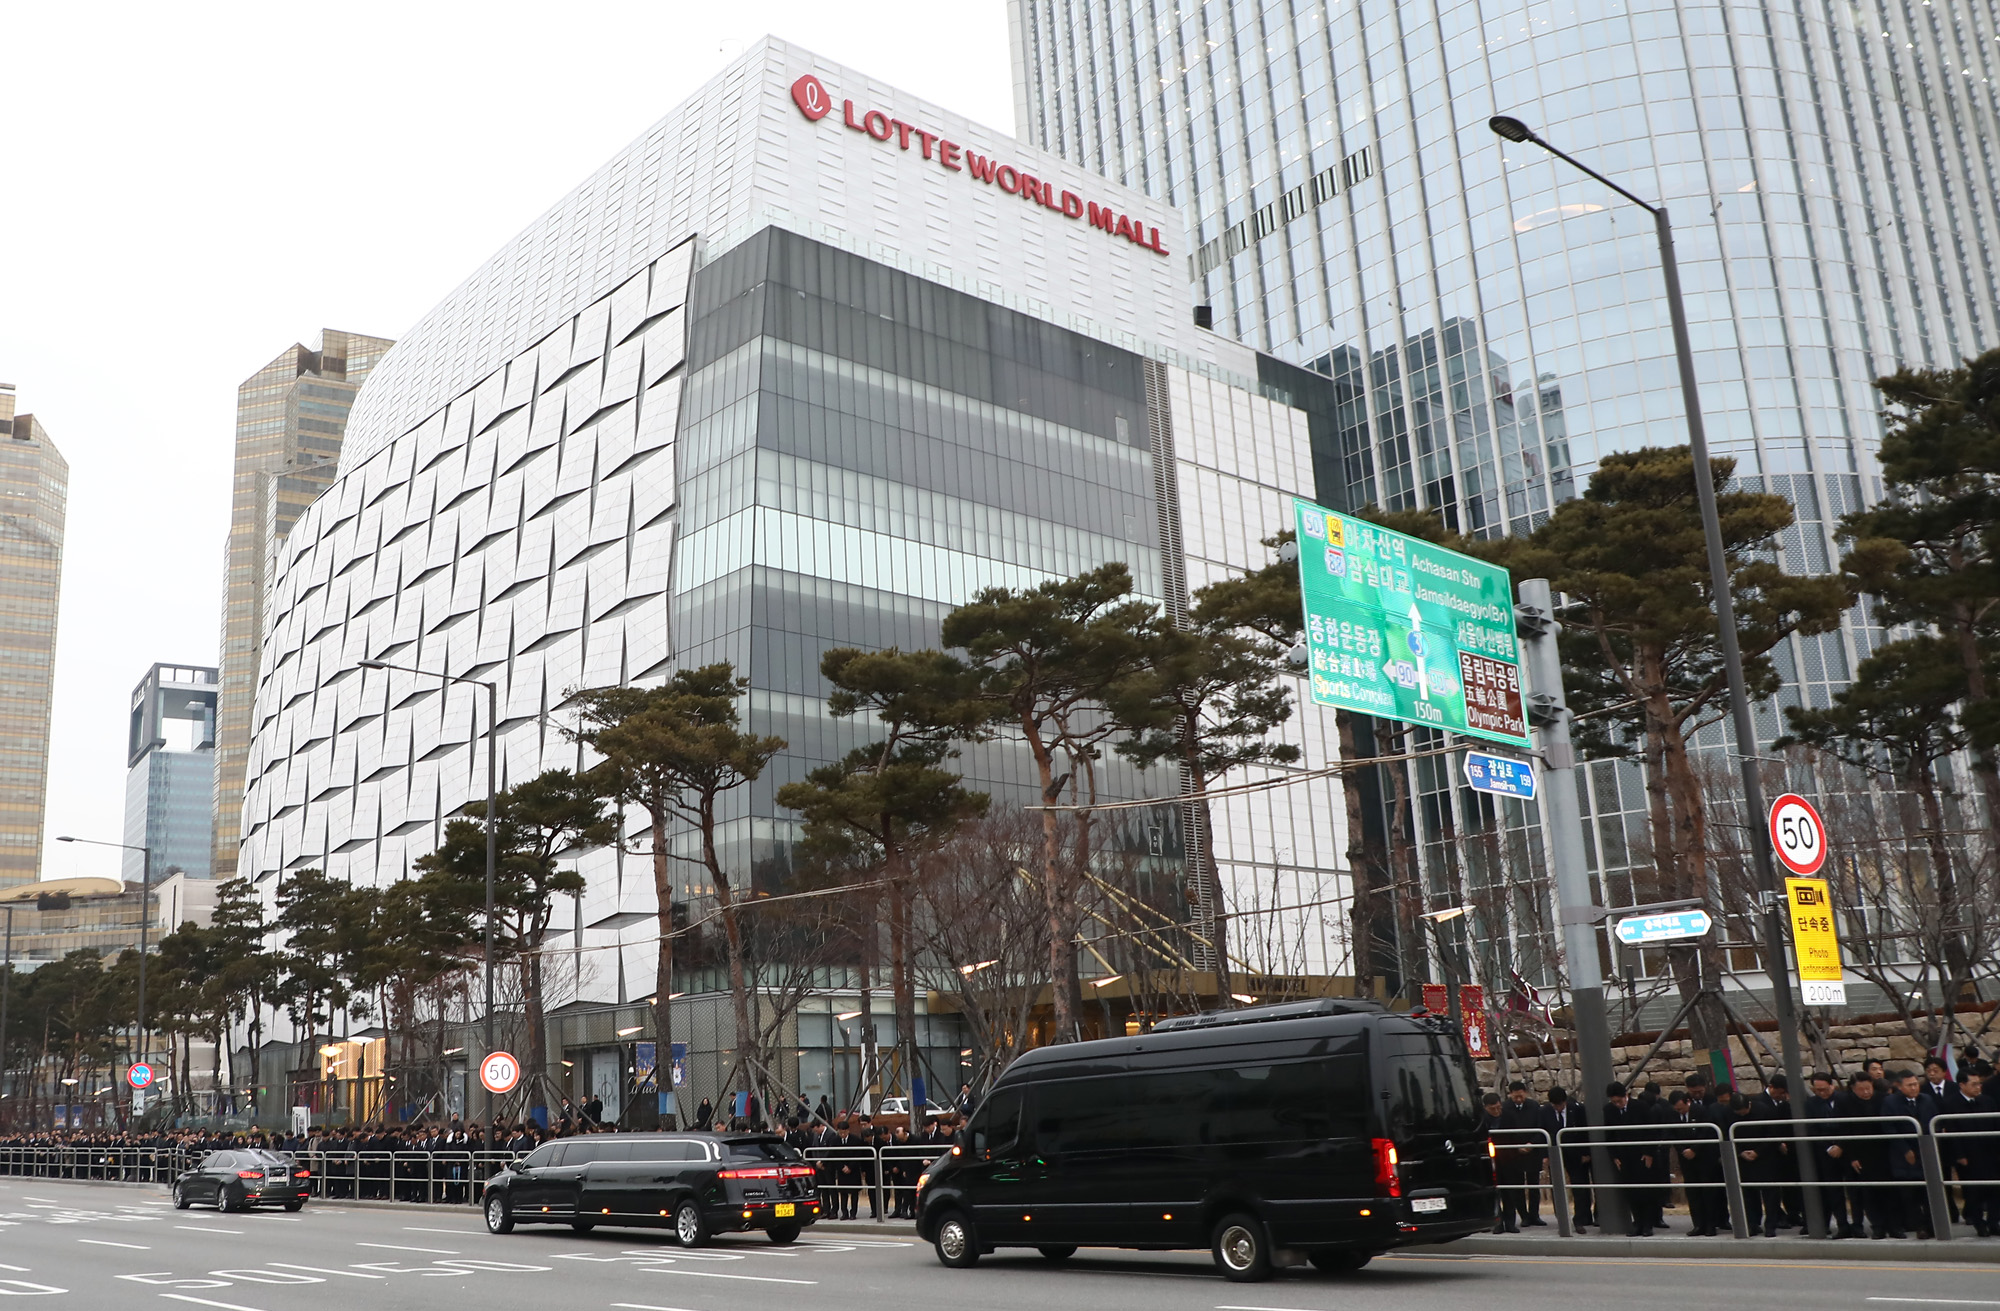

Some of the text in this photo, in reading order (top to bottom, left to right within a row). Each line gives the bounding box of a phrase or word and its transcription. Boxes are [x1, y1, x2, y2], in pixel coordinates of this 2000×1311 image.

[843, 98, 1170, 256] LOTTE WORLD MALL
[1306, 514, 1320, 534] 50
[1345, 523, 1407, 566] 아차산역
[1329, 554, 1344, 574] 88
[1347, 554, 1411, 594] 잠실대교
[1411, 553, 1481, 590] Achasan Stn
[1414, 583, 1510, 627] Jamsildaegyo(Br)
[1310, 613, 1381, 657] 종합운동장
[1458, 620, 1515, 658] 서울아산병원
[1314, 674, 1351, 698] Sports
[1398, 665, 1413, 684] 90
[1429, 671, 1446, 692] 90
[1462, 655, 1519, 693] 올림픽공원
[1413, 701, 1443, 723] 150m
[1467, 706, 1525, 733] Olympic Park
[1470, 764, 1483, 778] 155
[1488, 760, 1514, 778] 잠실로
[1783, 816, 1814, 850] 50
[1798, 916, 1829, 932] 단속중
[1808, 947, 1829, 958] Photo
[1808, 986, 1843, 1001] 200m
[489, 1063, 512, 1082] 50
